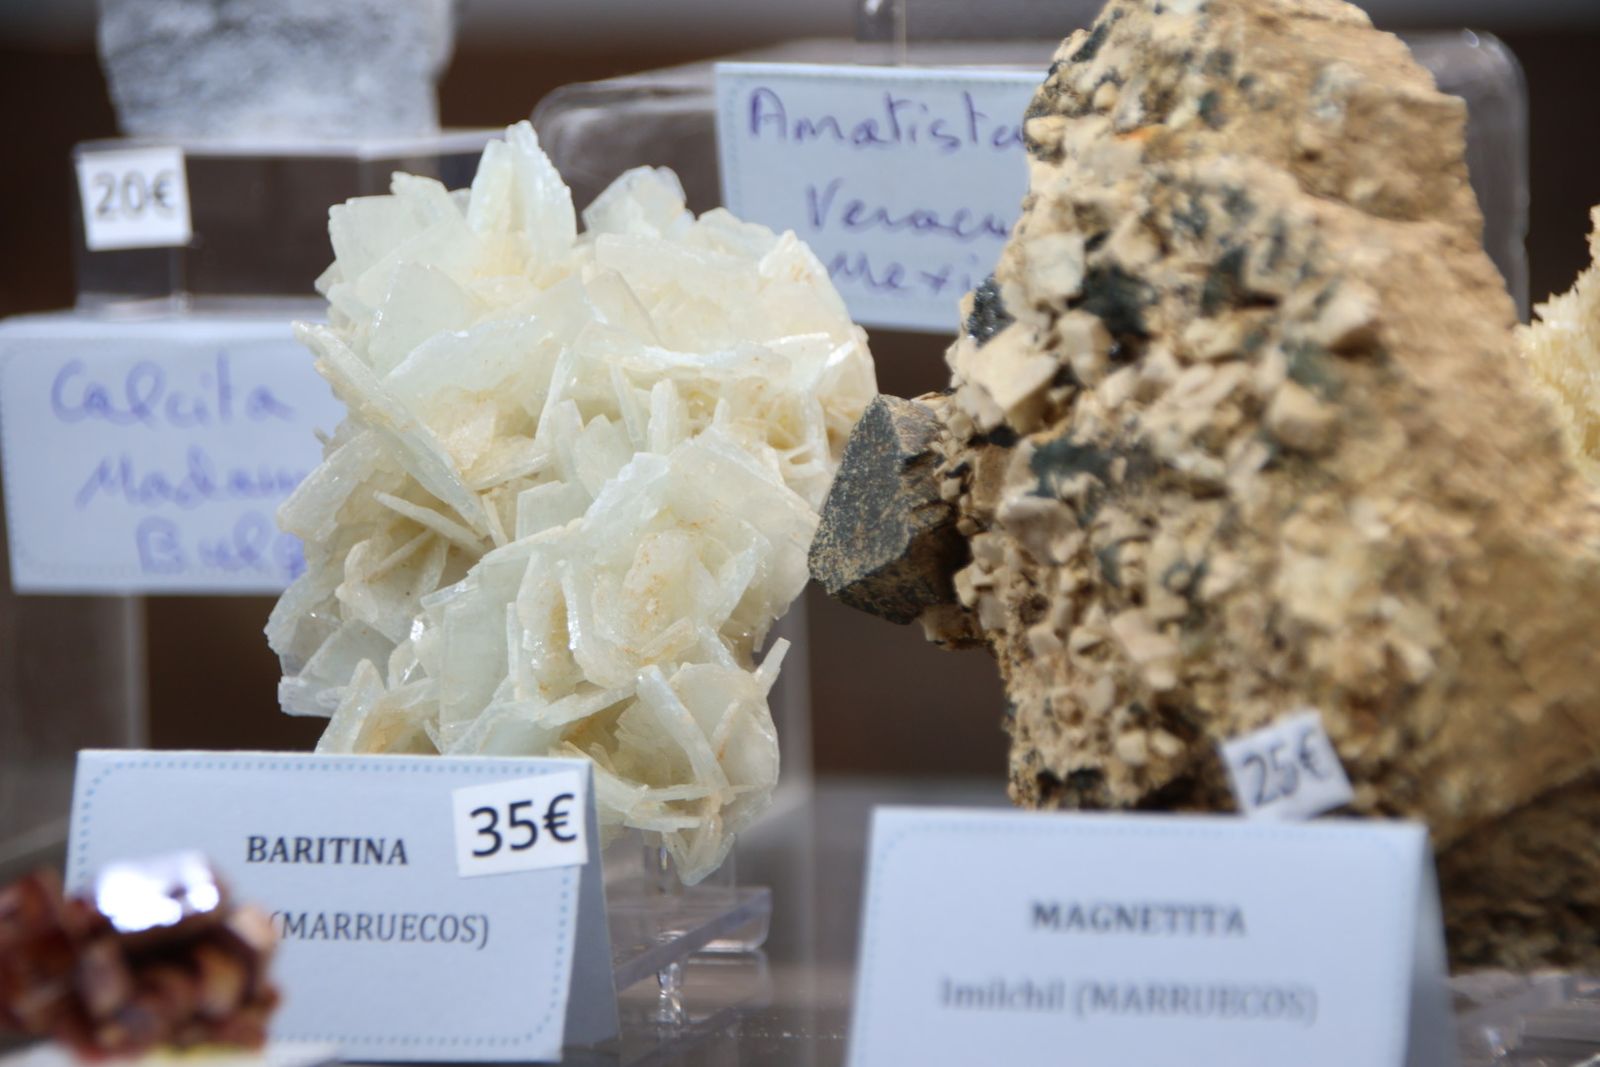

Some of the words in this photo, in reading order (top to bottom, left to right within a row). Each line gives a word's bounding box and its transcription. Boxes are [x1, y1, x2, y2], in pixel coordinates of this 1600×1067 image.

[93, 169, 176, 222] 20€
[1242, 728, 1325, 807] 25€
[469, 793, 577, 857] 35€
[246, 836, 409, 866] BARITINA
[1031, 901, 1247, 936] MAGNETITA
[1075, 981, 1319, 1026] (MARRUECOS)
